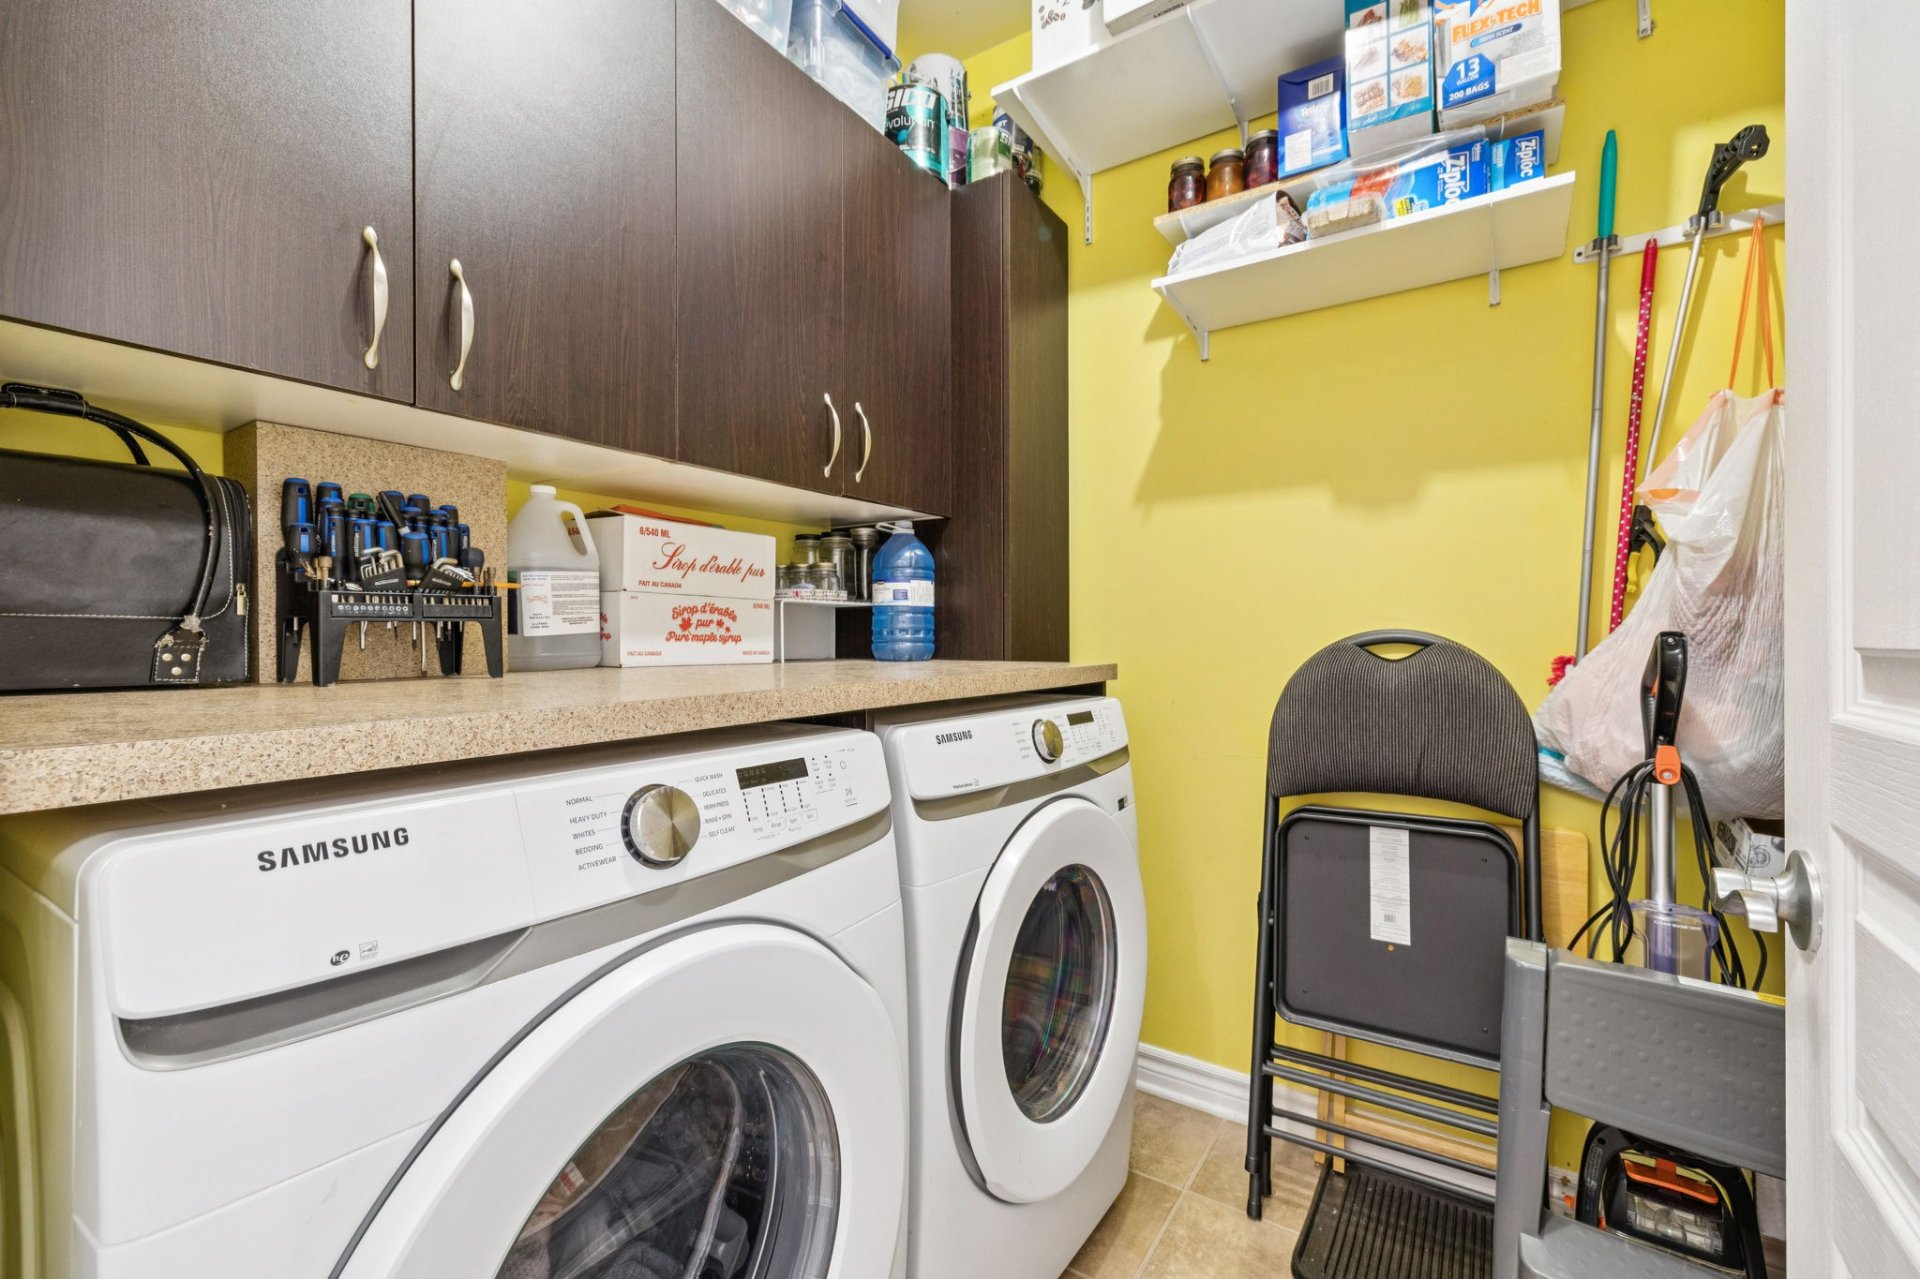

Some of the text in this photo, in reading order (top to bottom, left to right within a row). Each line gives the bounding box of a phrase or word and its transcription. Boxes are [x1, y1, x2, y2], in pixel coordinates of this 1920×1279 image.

[1456, 57, 1480, 79] 13
[1448, 81, 1490, 102] 200 BAGS
[1516, 138, 1537, 178] Ziploc
[639, 526, 671, 538] 8/540 ML
[652, 541, 766, 583] Sirop d'érable pur
[672, 602, 738, 622] Sirop d'érable
[695, 617, 714, 630] pur
[665, 630, 743, 645] Pure maple syrup
[936, 730, 973, 745] SAMSUNG
[694, 774, 709, 783] QUICK
[702, 787, 727, 798] DELICATES
[565, 795, 593, 806] NORMAL
[569, 811, 607, 825] HEAVY DUTY
[572, 829, 596, 840] WHITES
[708, 829, 720, 838] SELF
[257, 826, 410, 873] SAMSUNG
[575, 843, 604, 856] BEDDING
[578, 855, 618, 871] ACTIVEWEAR
